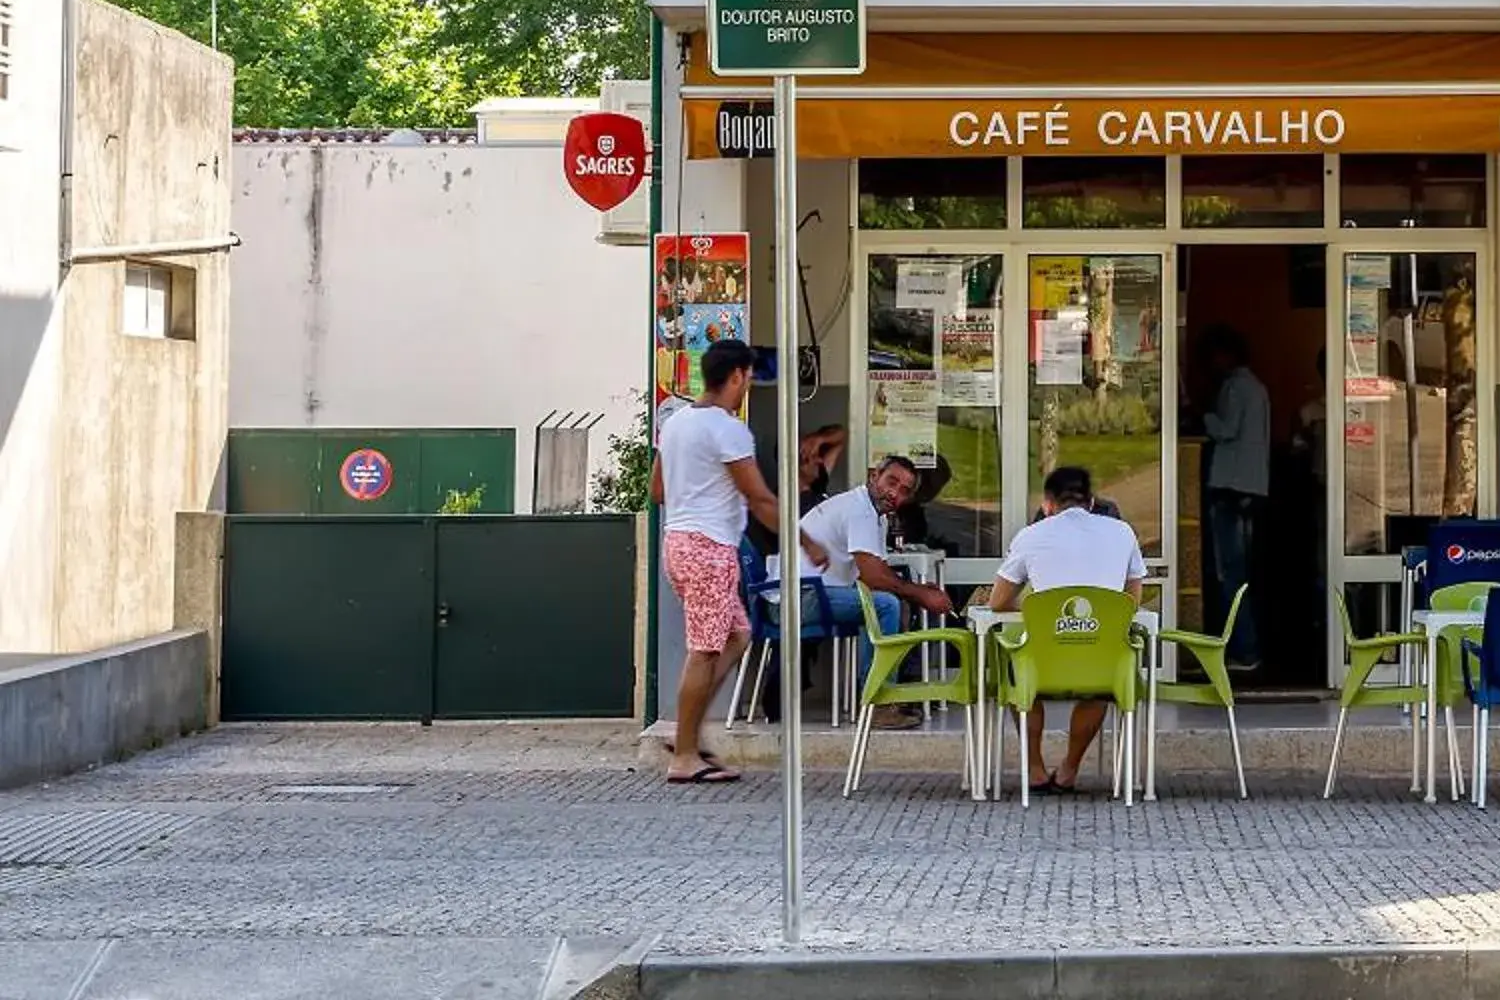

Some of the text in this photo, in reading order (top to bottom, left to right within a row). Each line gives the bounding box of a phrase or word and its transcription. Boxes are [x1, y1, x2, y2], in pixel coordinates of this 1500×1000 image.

[720, 9, 855, 25] DOUTOR AUGUSTO
[767, 27, 810, 43] BRITO
[719, 110, 777, 158] Bogan
[949, 103, 1346, 147] CAFÉ CARVALHO
[575, 154, 636, 176] SAGRES
